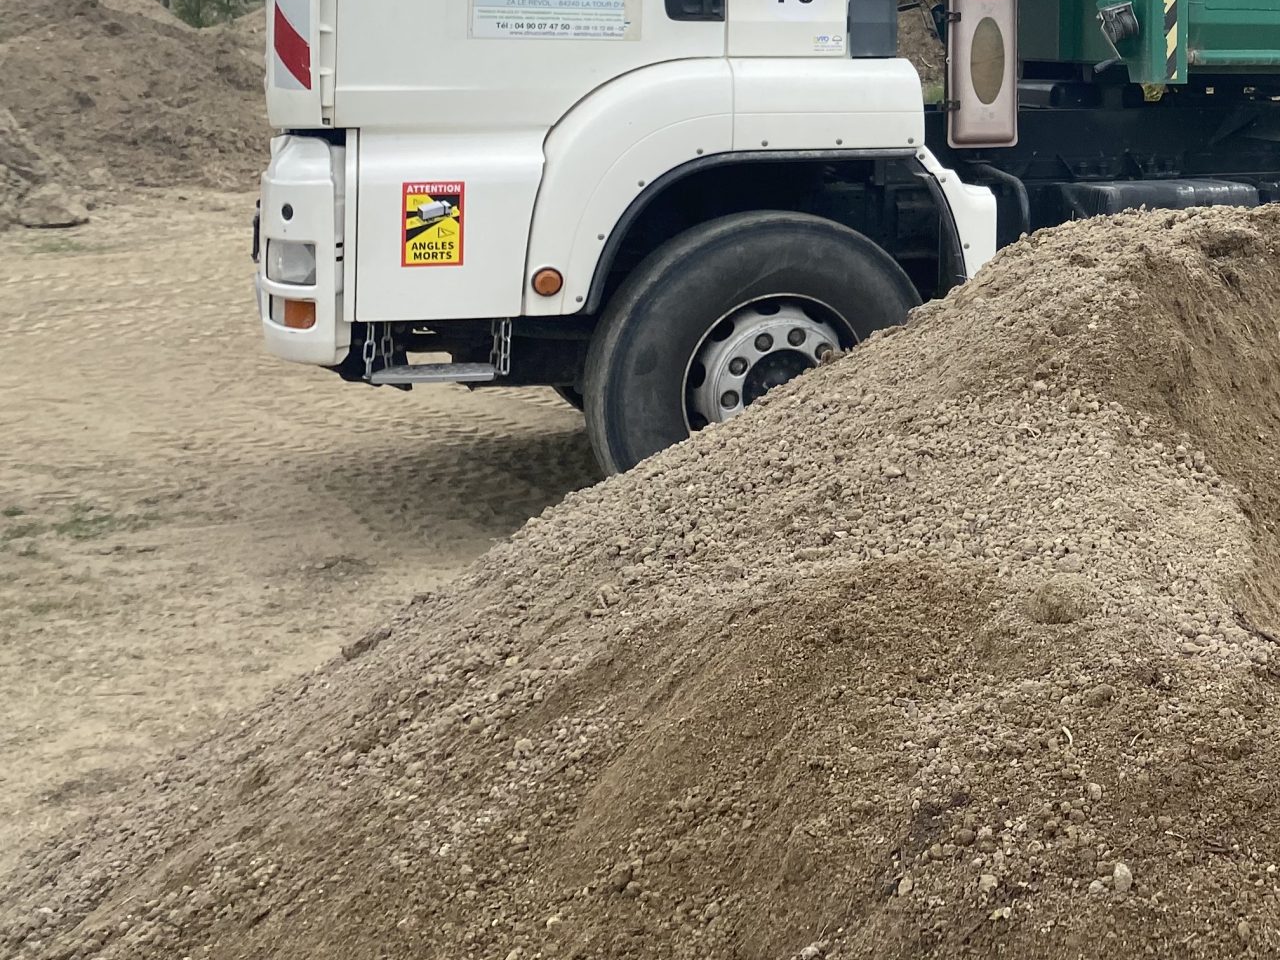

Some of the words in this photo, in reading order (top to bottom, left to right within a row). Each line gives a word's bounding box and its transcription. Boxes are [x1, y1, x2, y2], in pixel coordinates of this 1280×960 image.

[406, 185, 461, 193] ATTENTION
[411, 242, 454, 251] ANGLES
[413, 251, 452, 260] MORTS
